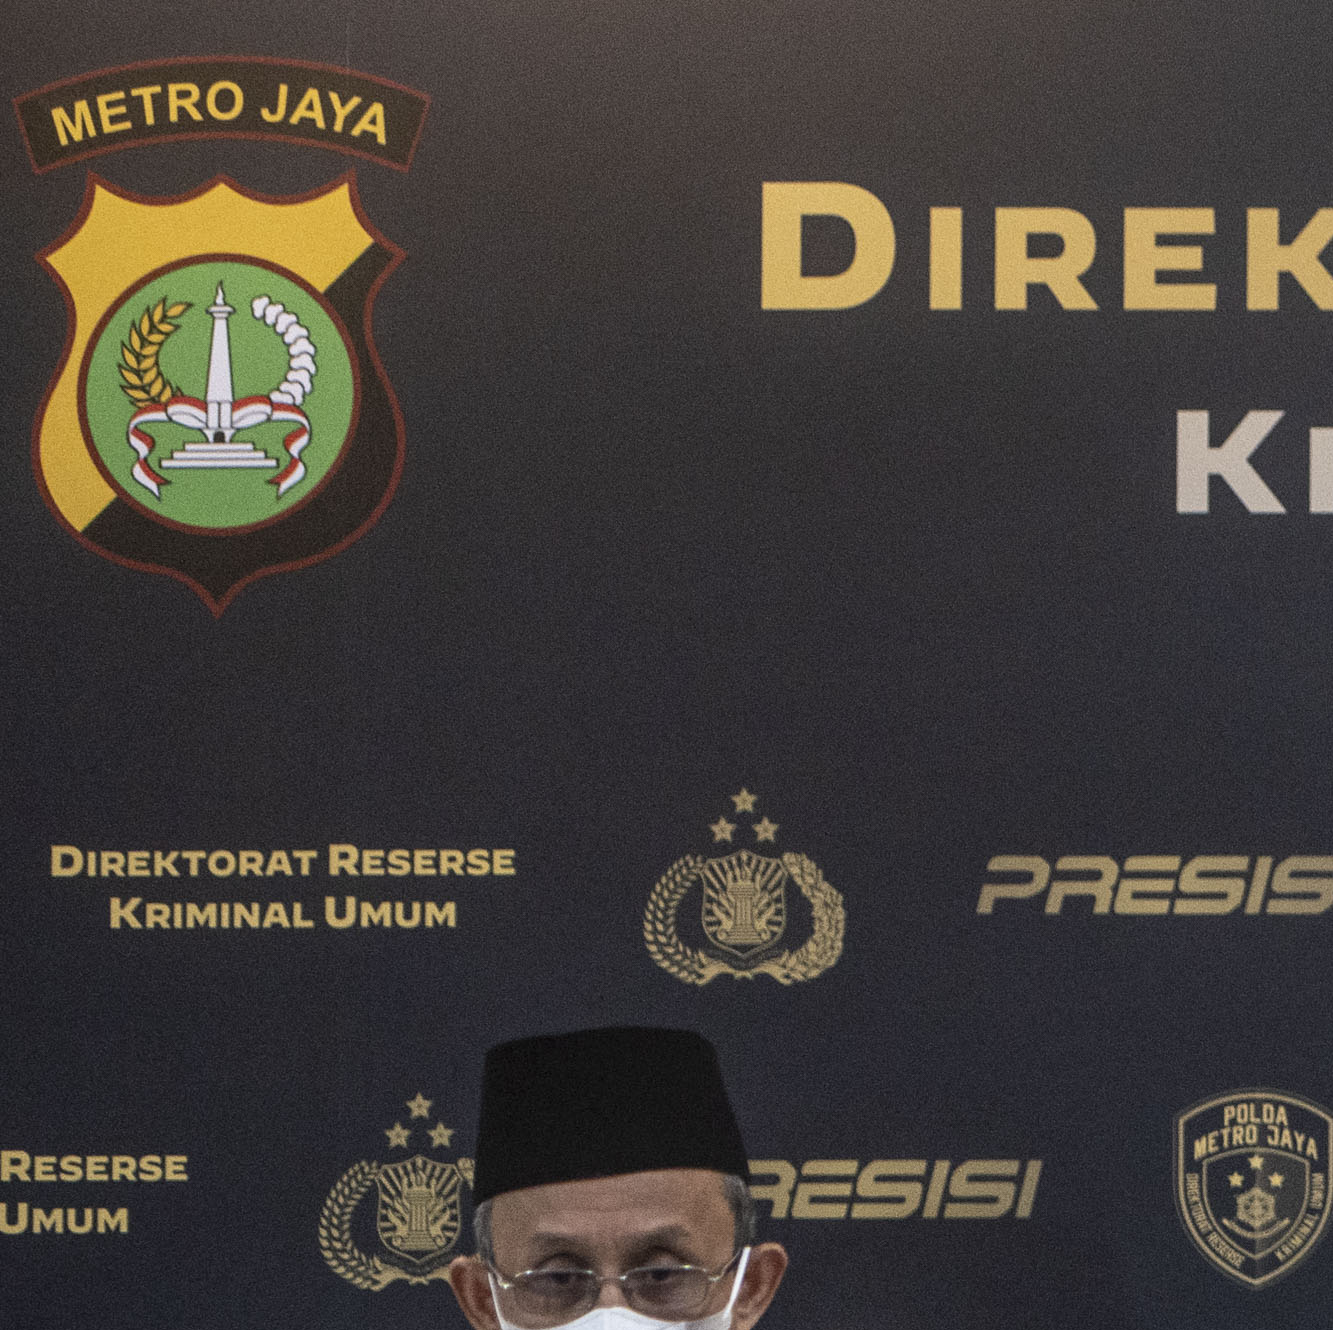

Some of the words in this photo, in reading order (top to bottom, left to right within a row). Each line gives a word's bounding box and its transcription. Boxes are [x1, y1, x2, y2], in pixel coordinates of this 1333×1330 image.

[51, 80, 244, 146] METRO
[260, 83, 387, 145] JAYA
[51, 845, 318, 877] DIREKTORAT
[328, 843, 516, 877] RESERSE
[109, 897, 315, 929] KRIMINAL
[324, 895, 457, 929] UMUM
[1223, 1103, 1288, 1126] POLDA
[1194, 1124, 1259, 1160] METRO
[1267, 1125, 1318, 1160] JAYA
[0, 1150, 189, 1182] RESERSE
[747, 1159, 1042, 1219] RESISI
[0, 1202, 129, 1235] UMUM
